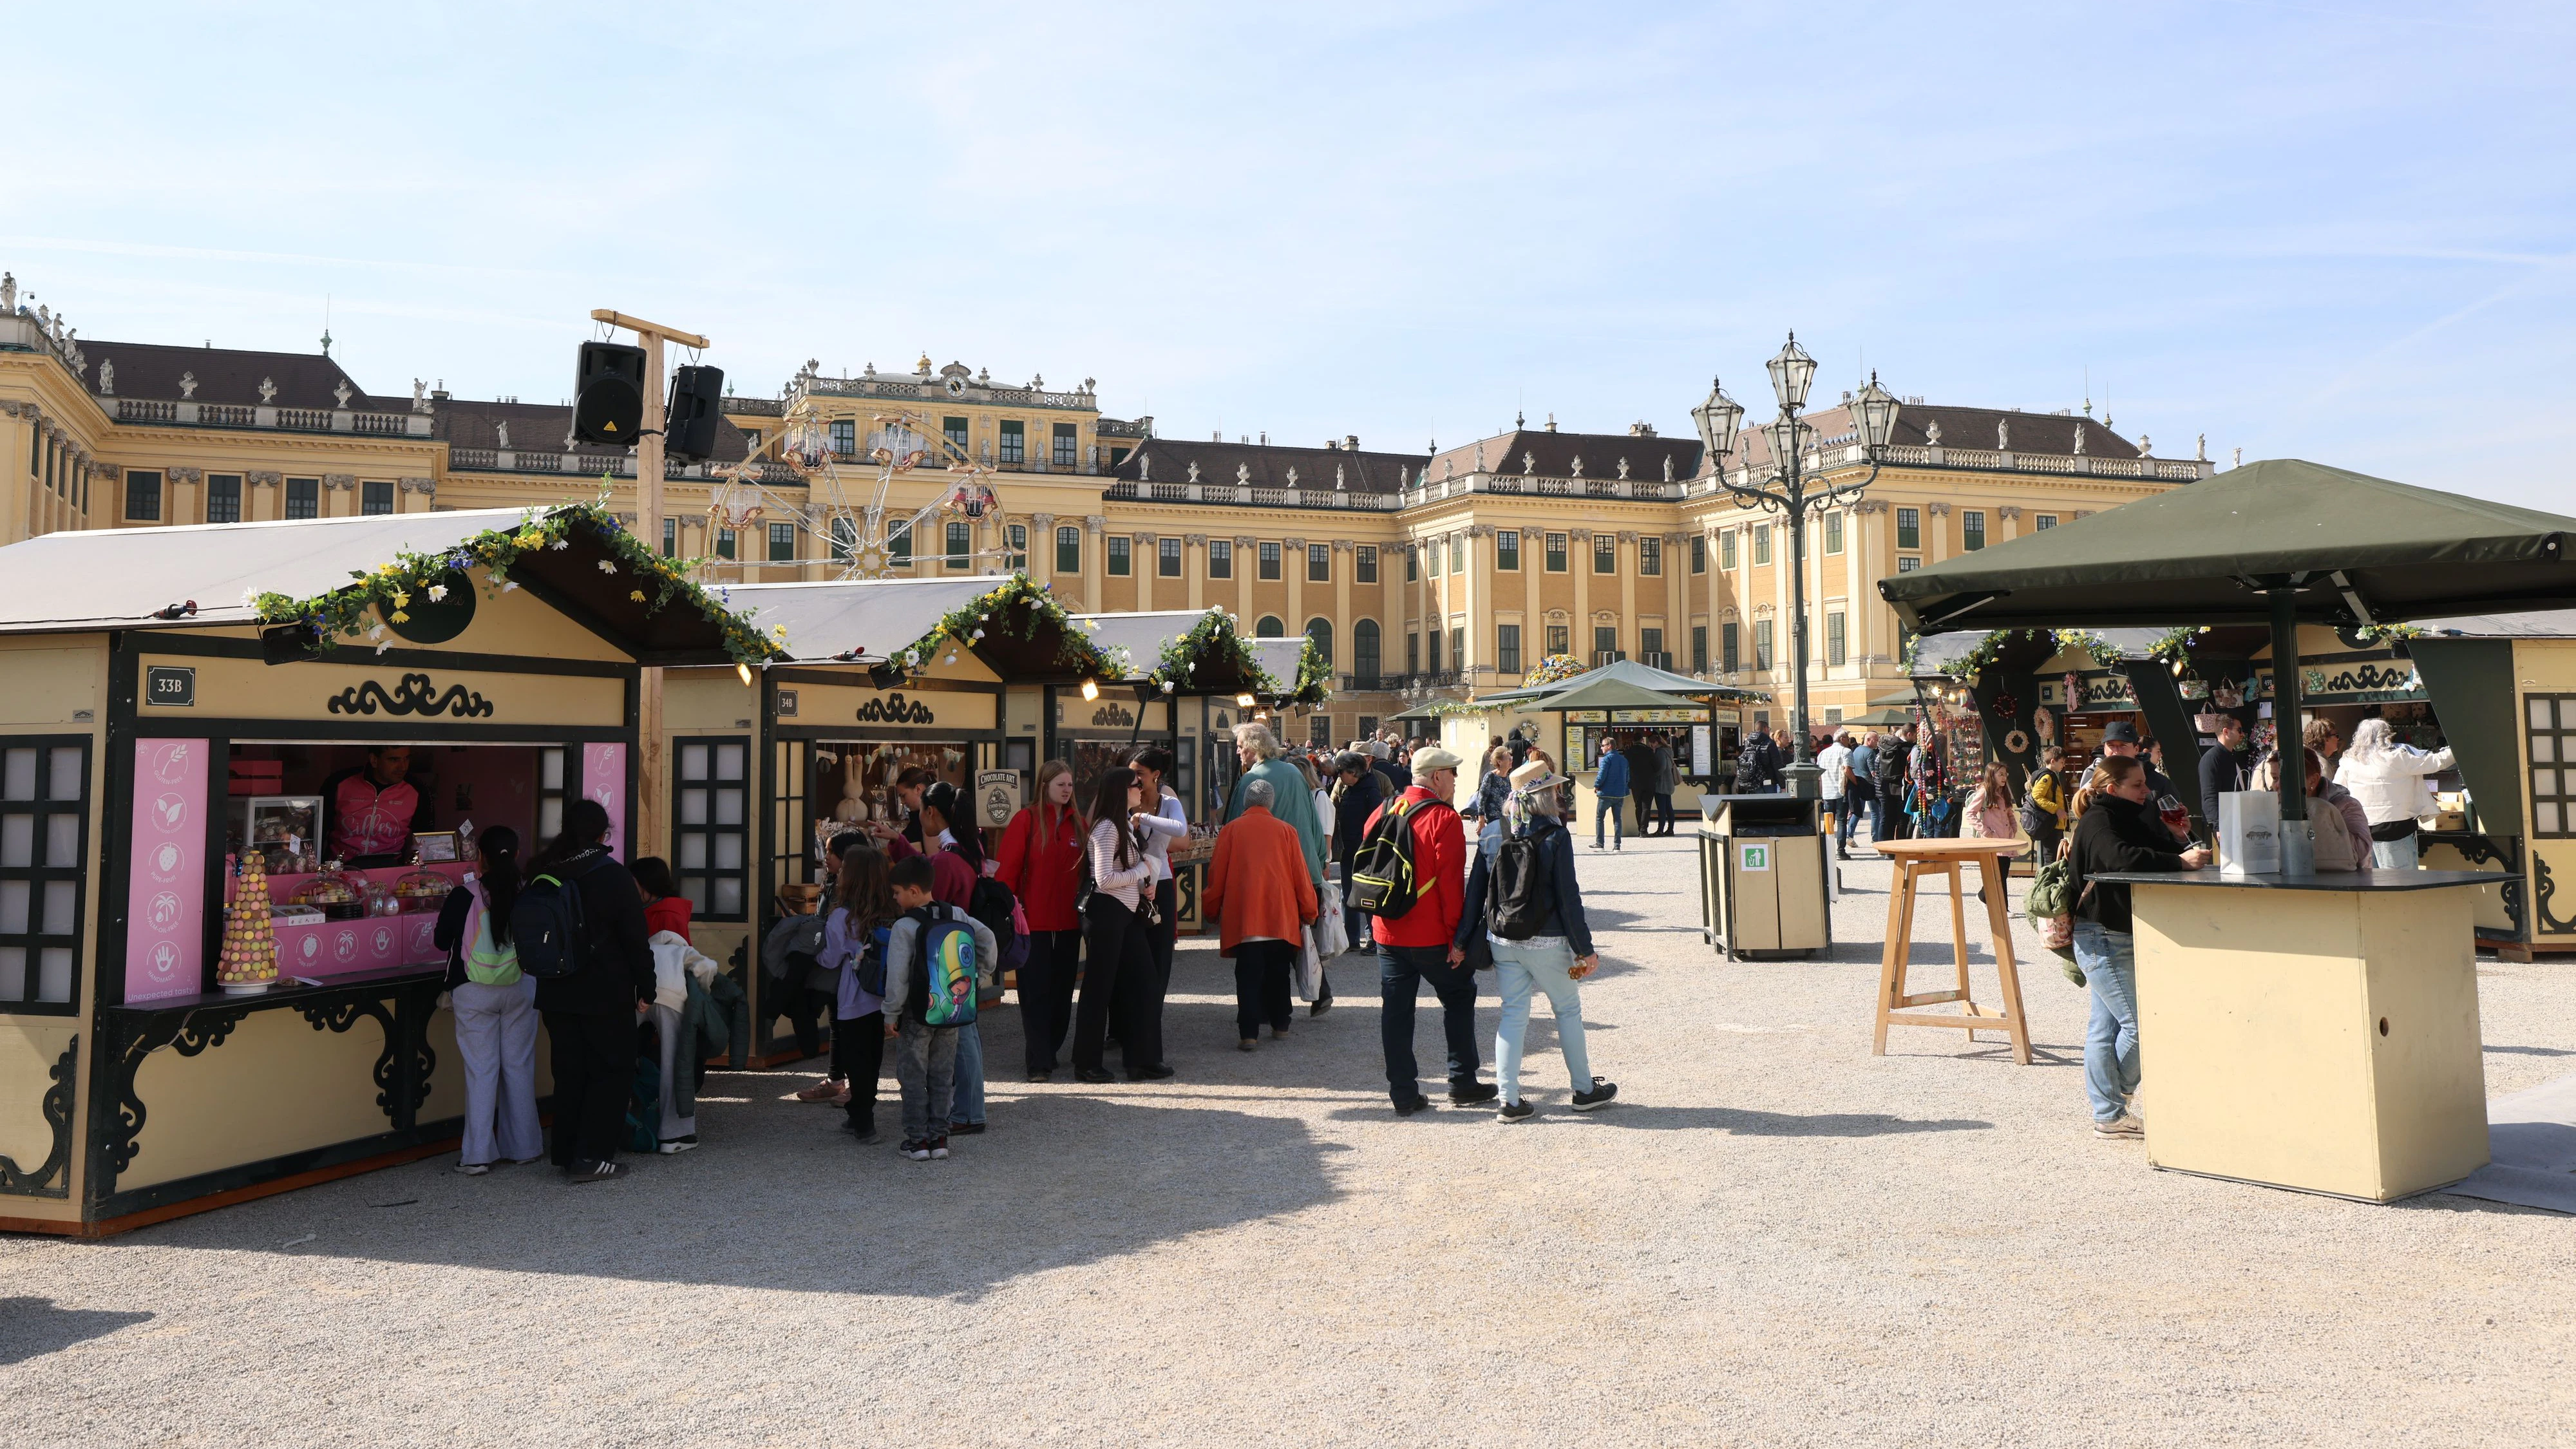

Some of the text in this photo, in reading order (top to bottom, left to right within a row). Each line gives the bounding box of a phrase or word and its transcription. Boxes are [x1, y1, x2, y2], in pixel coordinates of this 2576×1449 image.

[158, 679, 182, 692] 33B
[782, 698, 793, 707] 34B
[155, 770, 182, 784] GLUTEN-FREE
[980, 773, 1015, 784] CHOCOLATE ART
[341, 814, 397, 840] Siller
[150, 871, 176, 884] PURE-FRUIT
[146, 916, 179, 934] PALM-OIL-FREE
[147, 970, 175, 983] HANDMADE
[128, 986, 195, 1001] Unexpected tasty!
